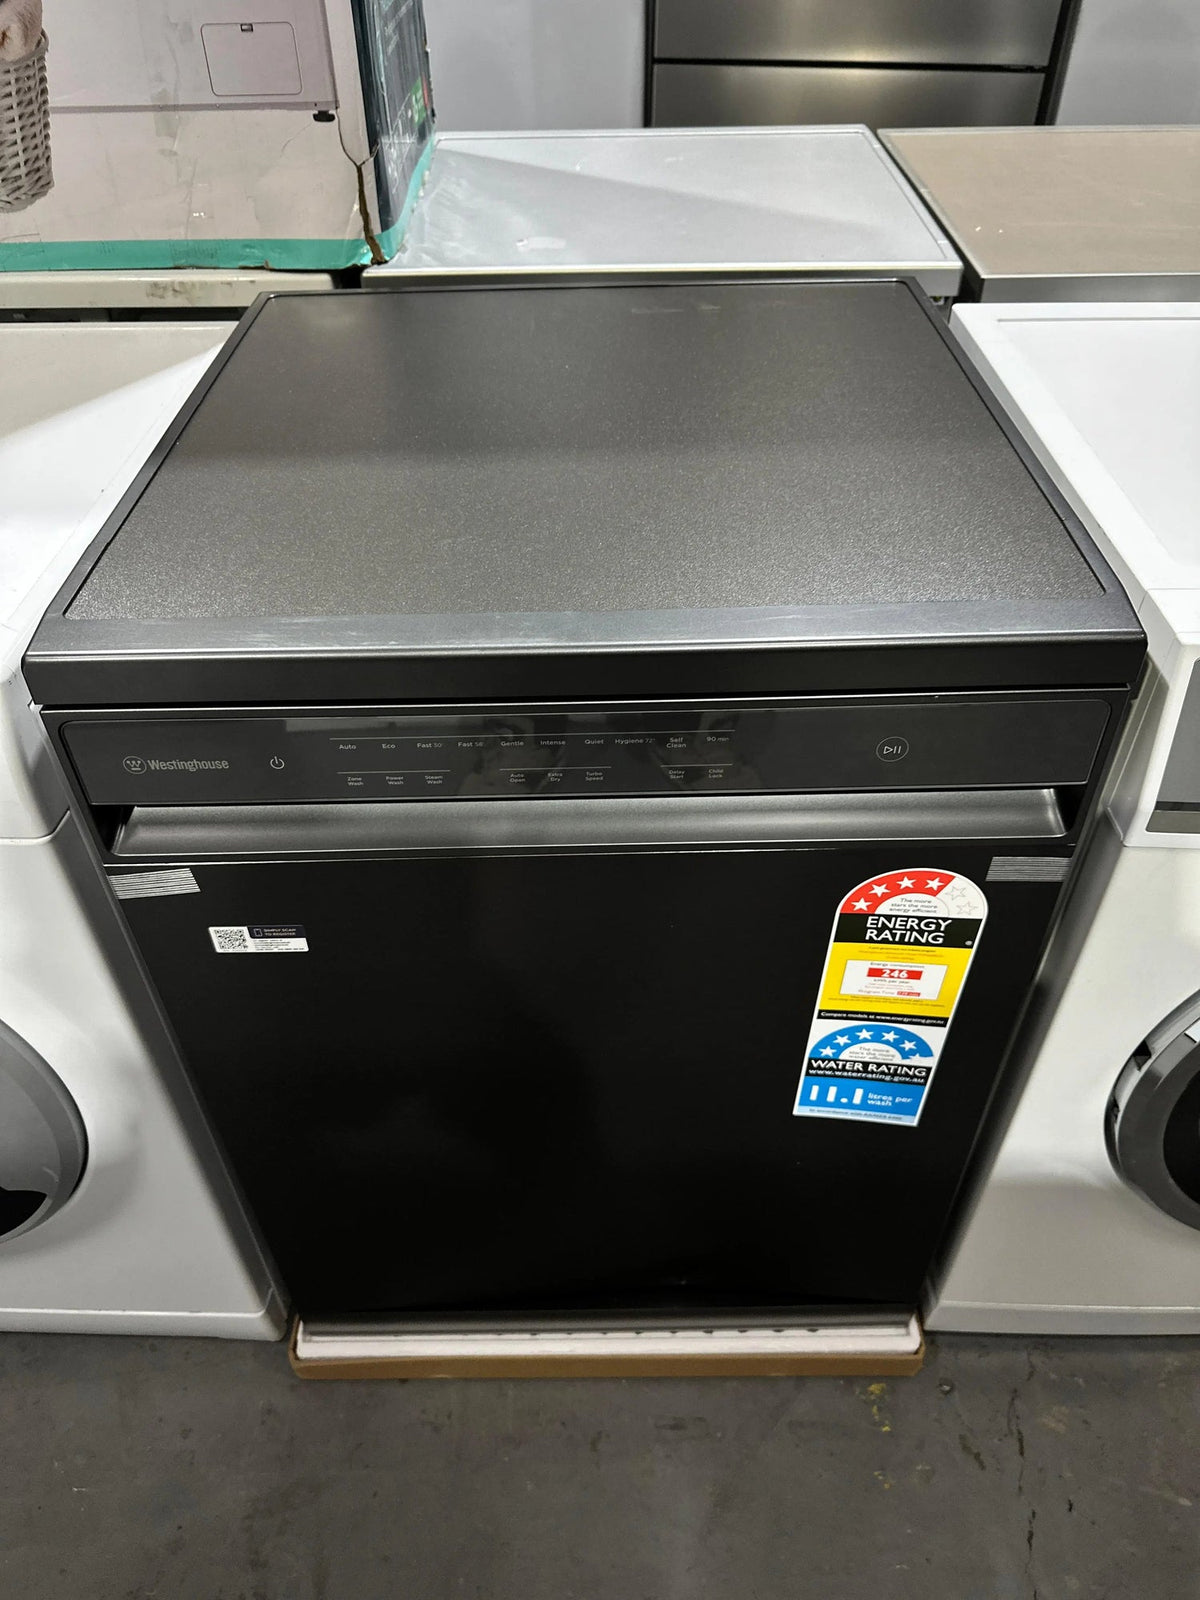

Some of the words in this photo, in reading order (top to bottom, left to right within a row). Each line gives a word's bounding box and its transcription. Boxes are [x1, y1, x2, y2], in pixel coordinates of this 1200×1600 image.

[584, 738, 604, 746] Quiet
[147, 759, 229, 772] Westinghouse
[865, 916, 953, 931] ENERGY
[865, 929, 946, 944] RATING
[881, 969, 909, 979] 246
[811, 1059, 864, 1071] WATER
[867, 1062, 928, 1077] RATING
[808, 1068, 925, 1084] www.waterrating.gov.au
[809, 1084, 864, 1105] 11.1
[867, 1092, 893, 1101] litres
[867, 1099, 893, 1107] wash
